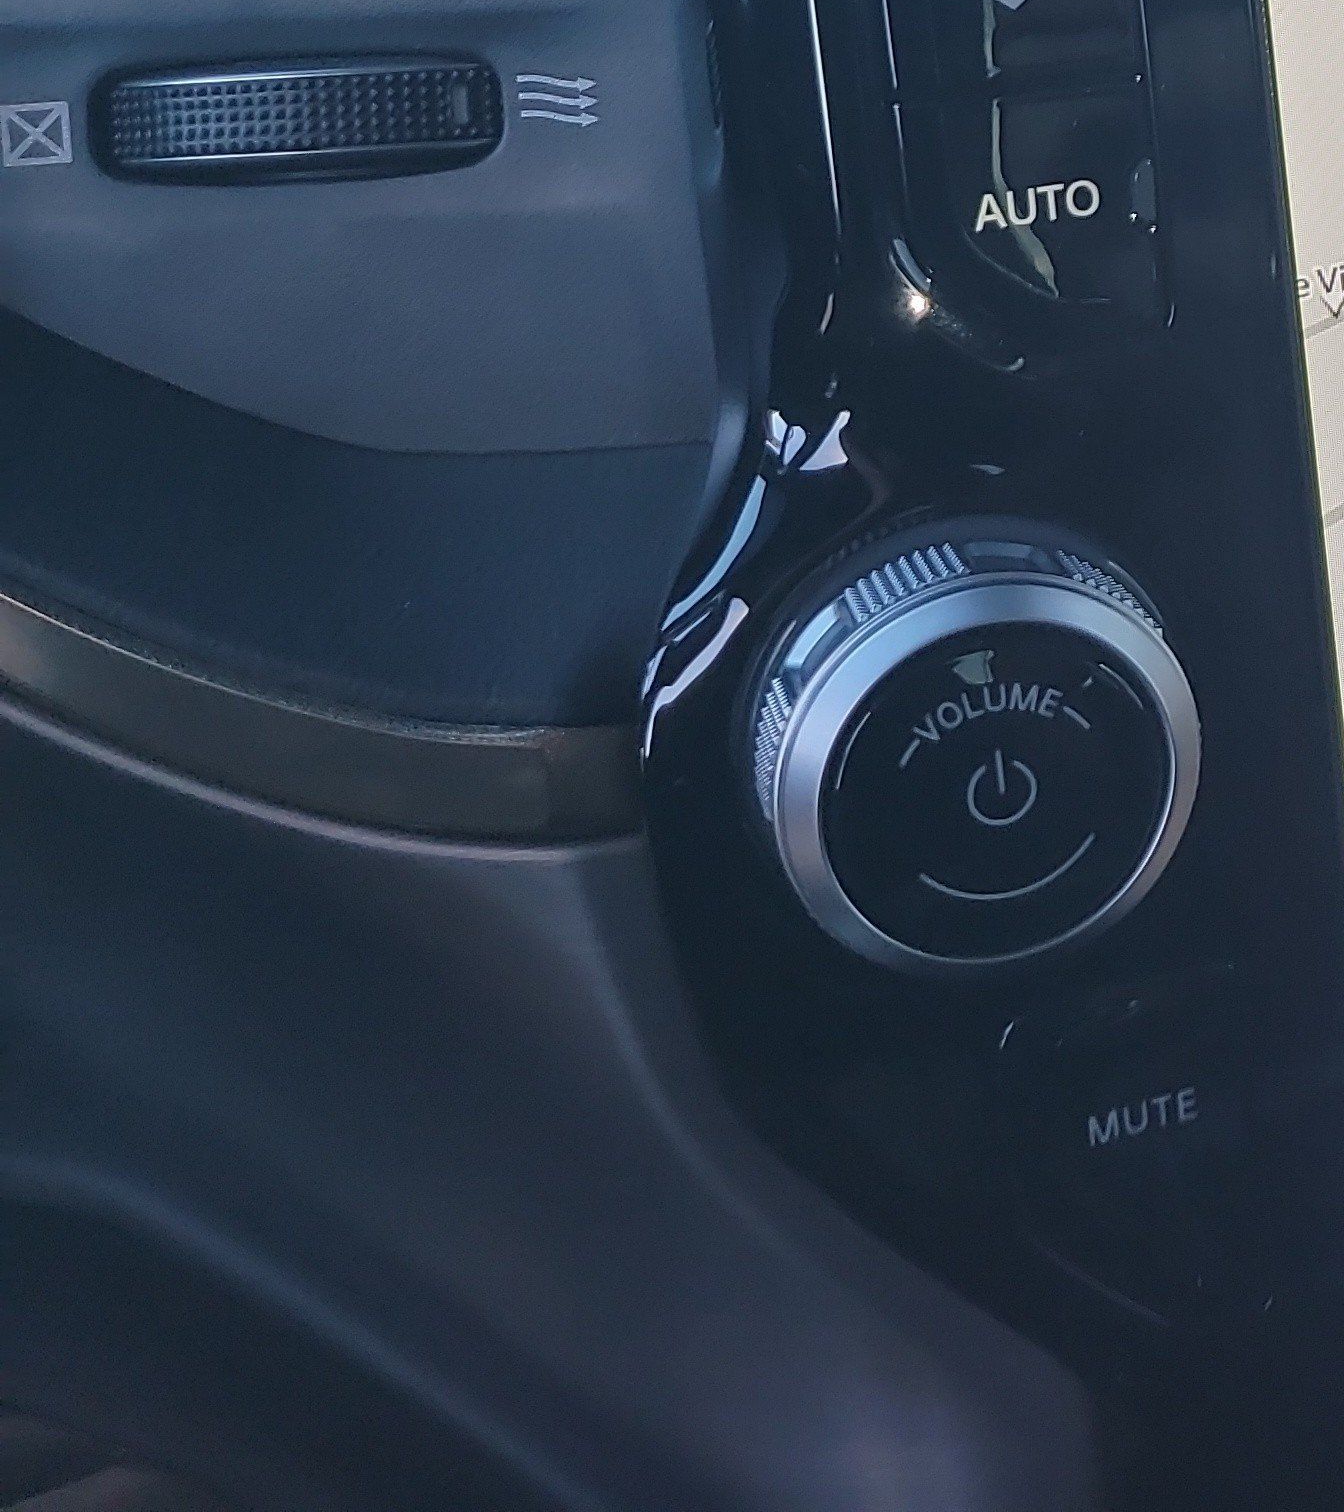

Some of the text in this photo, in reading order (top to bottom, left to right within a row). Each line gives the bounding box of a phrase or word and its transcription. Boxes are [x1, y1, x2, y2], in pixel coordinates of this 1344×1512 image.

[974, 178, 1101, 231] AUTO
[912, 684, 1063, 743] VOLUME
[1087, 1088, 1199, 1148] MUTE
